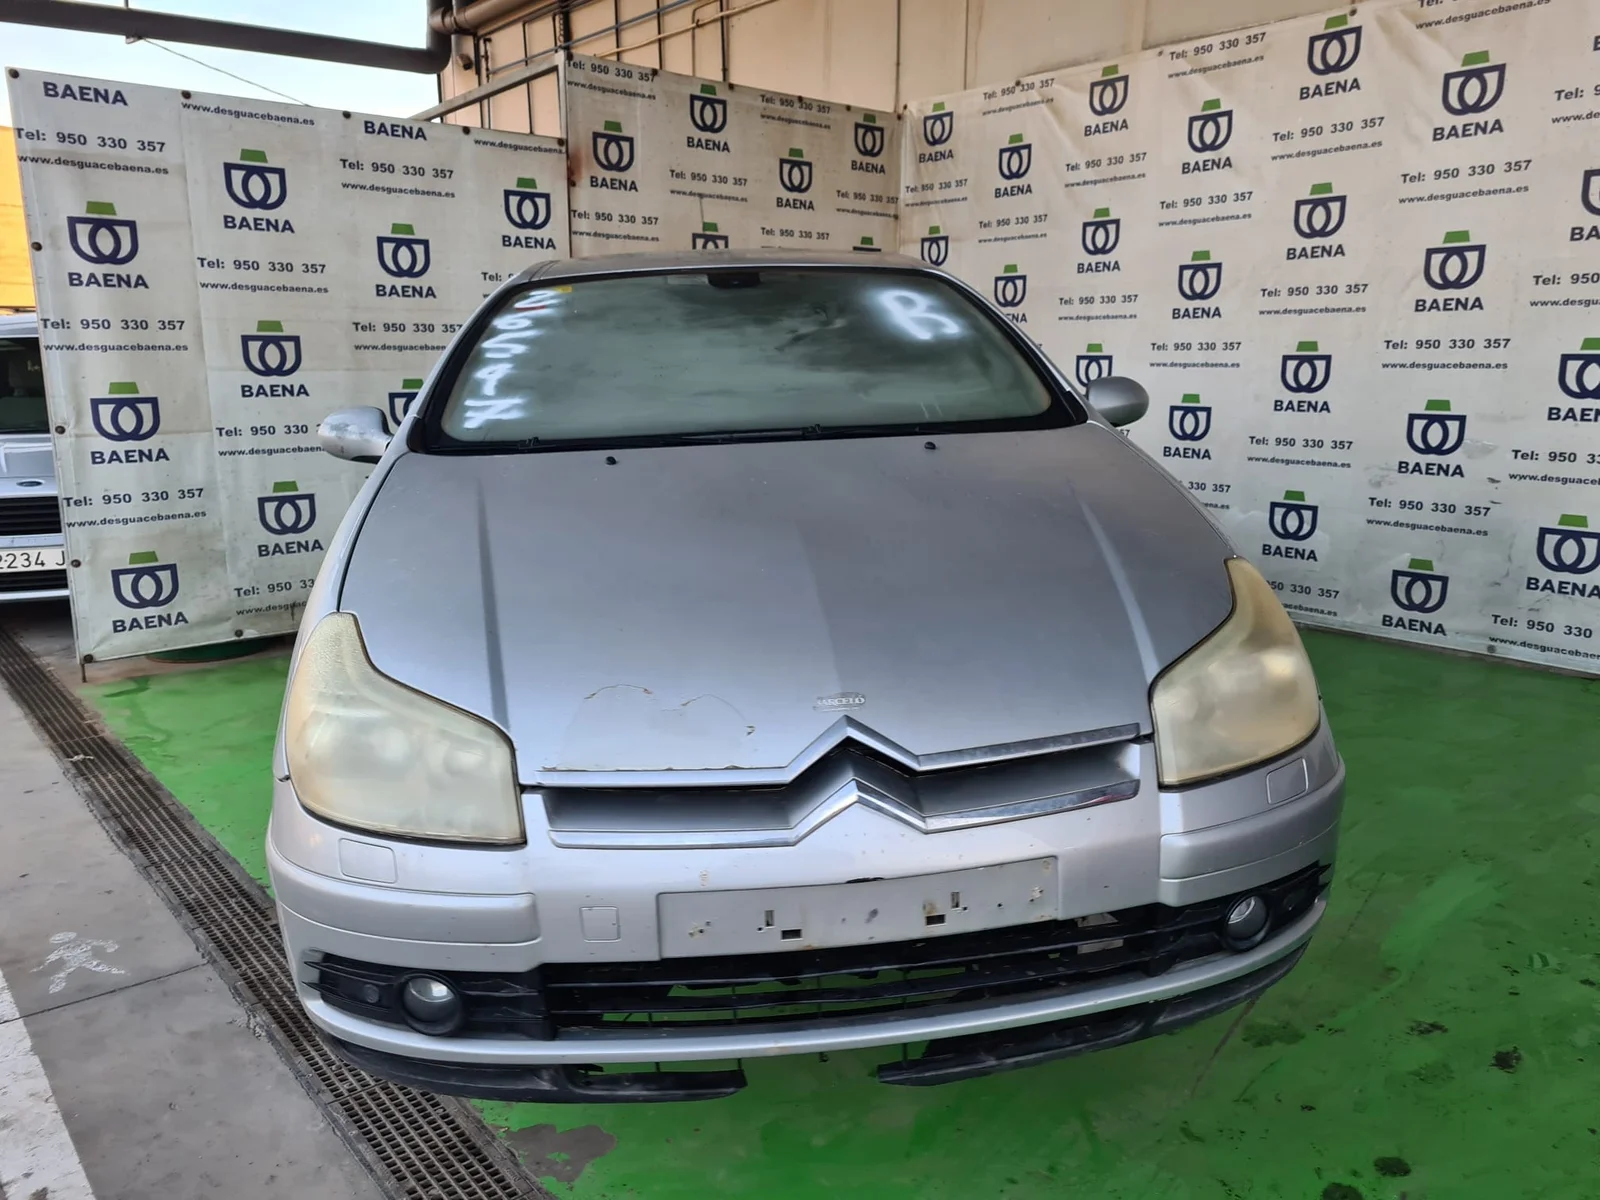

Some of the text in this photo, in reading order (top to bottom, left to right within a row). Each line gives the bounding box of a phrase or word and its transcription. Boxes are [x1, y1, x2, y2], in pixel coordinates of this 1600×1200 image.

[1169, 32, 1266, 60] Tel: 950 330 357
[43, 82, 128, 106] BAENA
[1300, 78, 1360, 100] BAENA
[181, 102, 315, 125] www.desguacebaena.es
[364, 121, 427, 140] BAENA
[1084, 119, 1128, 137] BAENA
[1273, 117, 1384, 141] Tel: 950 330 357
[1433, 119, 1503, 141] BAENA
[16, 128, 165, 152] Tel: 950 330 357
[474, 137, 566, 156] www.desguacebaena.
[687, 136, 730, 152] BAENA
[919, 149, 954, 163] BAENA
[1271, 141, 1382, 161] www.desguacebaena.es
[18, 154, 168, 174] www.desguacebaena.es
[340, 159, 453, 179] Tel: 950 330 357
[851, 160, 885, 174] BAENA
[1066, 152, 1147, 172] Tel: 950 330 357
[1182, 157, 1232, 174] BAENA
[670, 169, 747, 186] Tel: 950 330 357
[1401, 159, 1532, 183] Tel: 950 330 357
[341, 183, 455, 198] www.desguacebaena.es
[590, 176, 638, 192] BAENA
[995, 184, 1032, 198] BAENA
[1160, 191, 1253, 209] Tel: 950 330 357
[1399, 186, 1529, 203] www.desguacebaena.es
[777, 197, 814, 211] BAENA
[223, 215, 295, 233] BAENA
[571, 209, 658, 225] Tel: 950 330 357
[997, 218, 1010, 227] 950
[1015, 216, 1029, 225] 330
[1034, 214, 1048, 223] 357
[502, 235, 556, 250] BAENA
[1287, 244, 1345, 260] BAENA
[197, 257, 326, 273] Tel: 950 330 357
[1077, 261, 1120, 273] BAENA
[68, 272, 149, 289] BAENA
[200, 282, 328, 293] www.desguacebaena.es
[376, 284, 436, 298] BAENA
[1261, 284, 1368, 297] Tel: 950 330 357
[1079, 296, 1094, 305] 950
[1100, 295, 1116, 304] 330
[1122, 294, 1138, 303] 357
[1415, 297, 1483, 312] BAENA
[1172, 307, 1221, 319] BAENA
[1259, 307, 1366, 316] www.desguacebaena.es
[40, 319, 184, 330] Tel: 950 330 357
[352, 322, 463, 333] Tel: 950 330 357
[44, 343, 188, 352] www.desguacebaena.es
[354, 343, 446, 352] www.desguacebaen
[1151, 342, 1241, 351] Tel: 950 330 357
[1384, 339, 1511, 349] Tel: 950 330 357
[1382, 362, 1508, 370] www.desguacebaena.es
[241, 384, 309, 397] BAENA
[1274, 400, 1330, 413] BAENA
[216, 427, 242, 437] Tel:
[251, 426, 275, 435] 950
[284, 425, 308, 434] 330
[218, 445, 328, 456] www.desguacebaen
[1249, 436, 1353, 450] Tel: 950 330 357
[91, 448, 170, 464] BAENA
[1163, 446, 1211, 460] BAENA
[1512, 450, 1577, 462] Tel: 950
[1247, 457, 1351, 468] www.desguacebaena.es
[1398, 461, 1464, 477] BAENA
[1188, 481, 1231, 492] 330 357
[62, 488, 203, 507] Tel: 950 330 357
[1369, 497, 1491, 516] Tel: 950 330 357
[66, 511, 206, 528] www.desguacebaena.es
[1366, 519, 1488, 536] www.desguacebaena.es
[258, 539, 324, 557] BAENA
[1262, 544, 1317, 561] BAENA
[234, 579, 315, 597] Tel: 950 33
[1290, 584, 1311, 595] 330
[1318, 588, 1339, 599] 357
[1526, 577, 1600, 599] BAENA
[113, 612, 189, 633] BAENA
[1382, 615, 1446, 636] BAENA
[1492, 614, 1592, 638] Tel: 950 330
